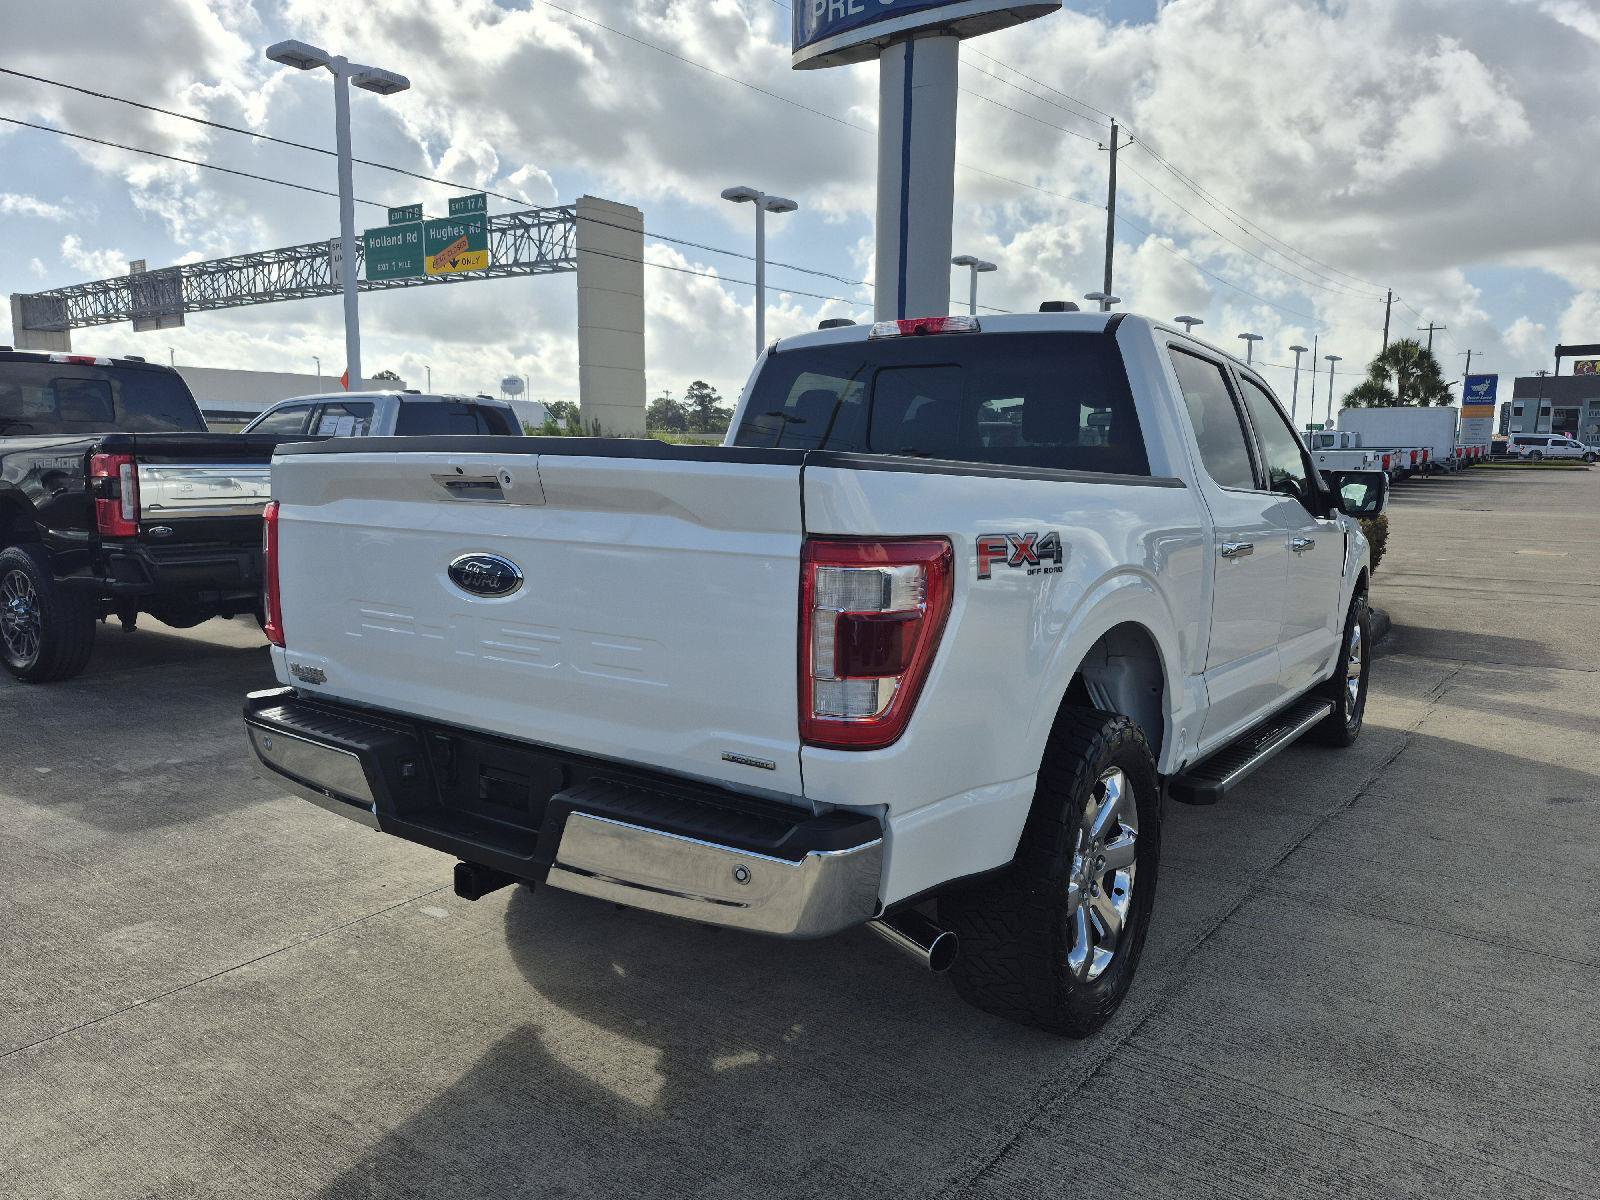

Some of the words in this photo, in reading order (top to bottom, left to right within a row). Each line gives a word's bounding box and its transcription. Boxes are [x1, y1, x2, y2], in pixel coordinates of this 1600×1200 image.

[451, 201, 464, 211] EXIT
[467, 199, 475, 210] 17
[477, 197, 484, 209] A
[391, 211, 403, 221] EXIT
[430, 225, 464, 241] Hughes
[469, 221, 481, 234] Rd
[370, 234, 402, 249] Holland
[406, 231, 418, 243] Rd
[378, 263, 389, 271] EXIT
[391, 261, 396, 271] 1
[399, 260, 412, 269] MILE
[461, 255, 481, 266] ONLY
[28, 457, 80, 469] TREMOR
[976, 532, 1062, 580] FX4
[1027, 567, 1041, 576] OFF
[1043, 566, 1063, 575] ROAD
